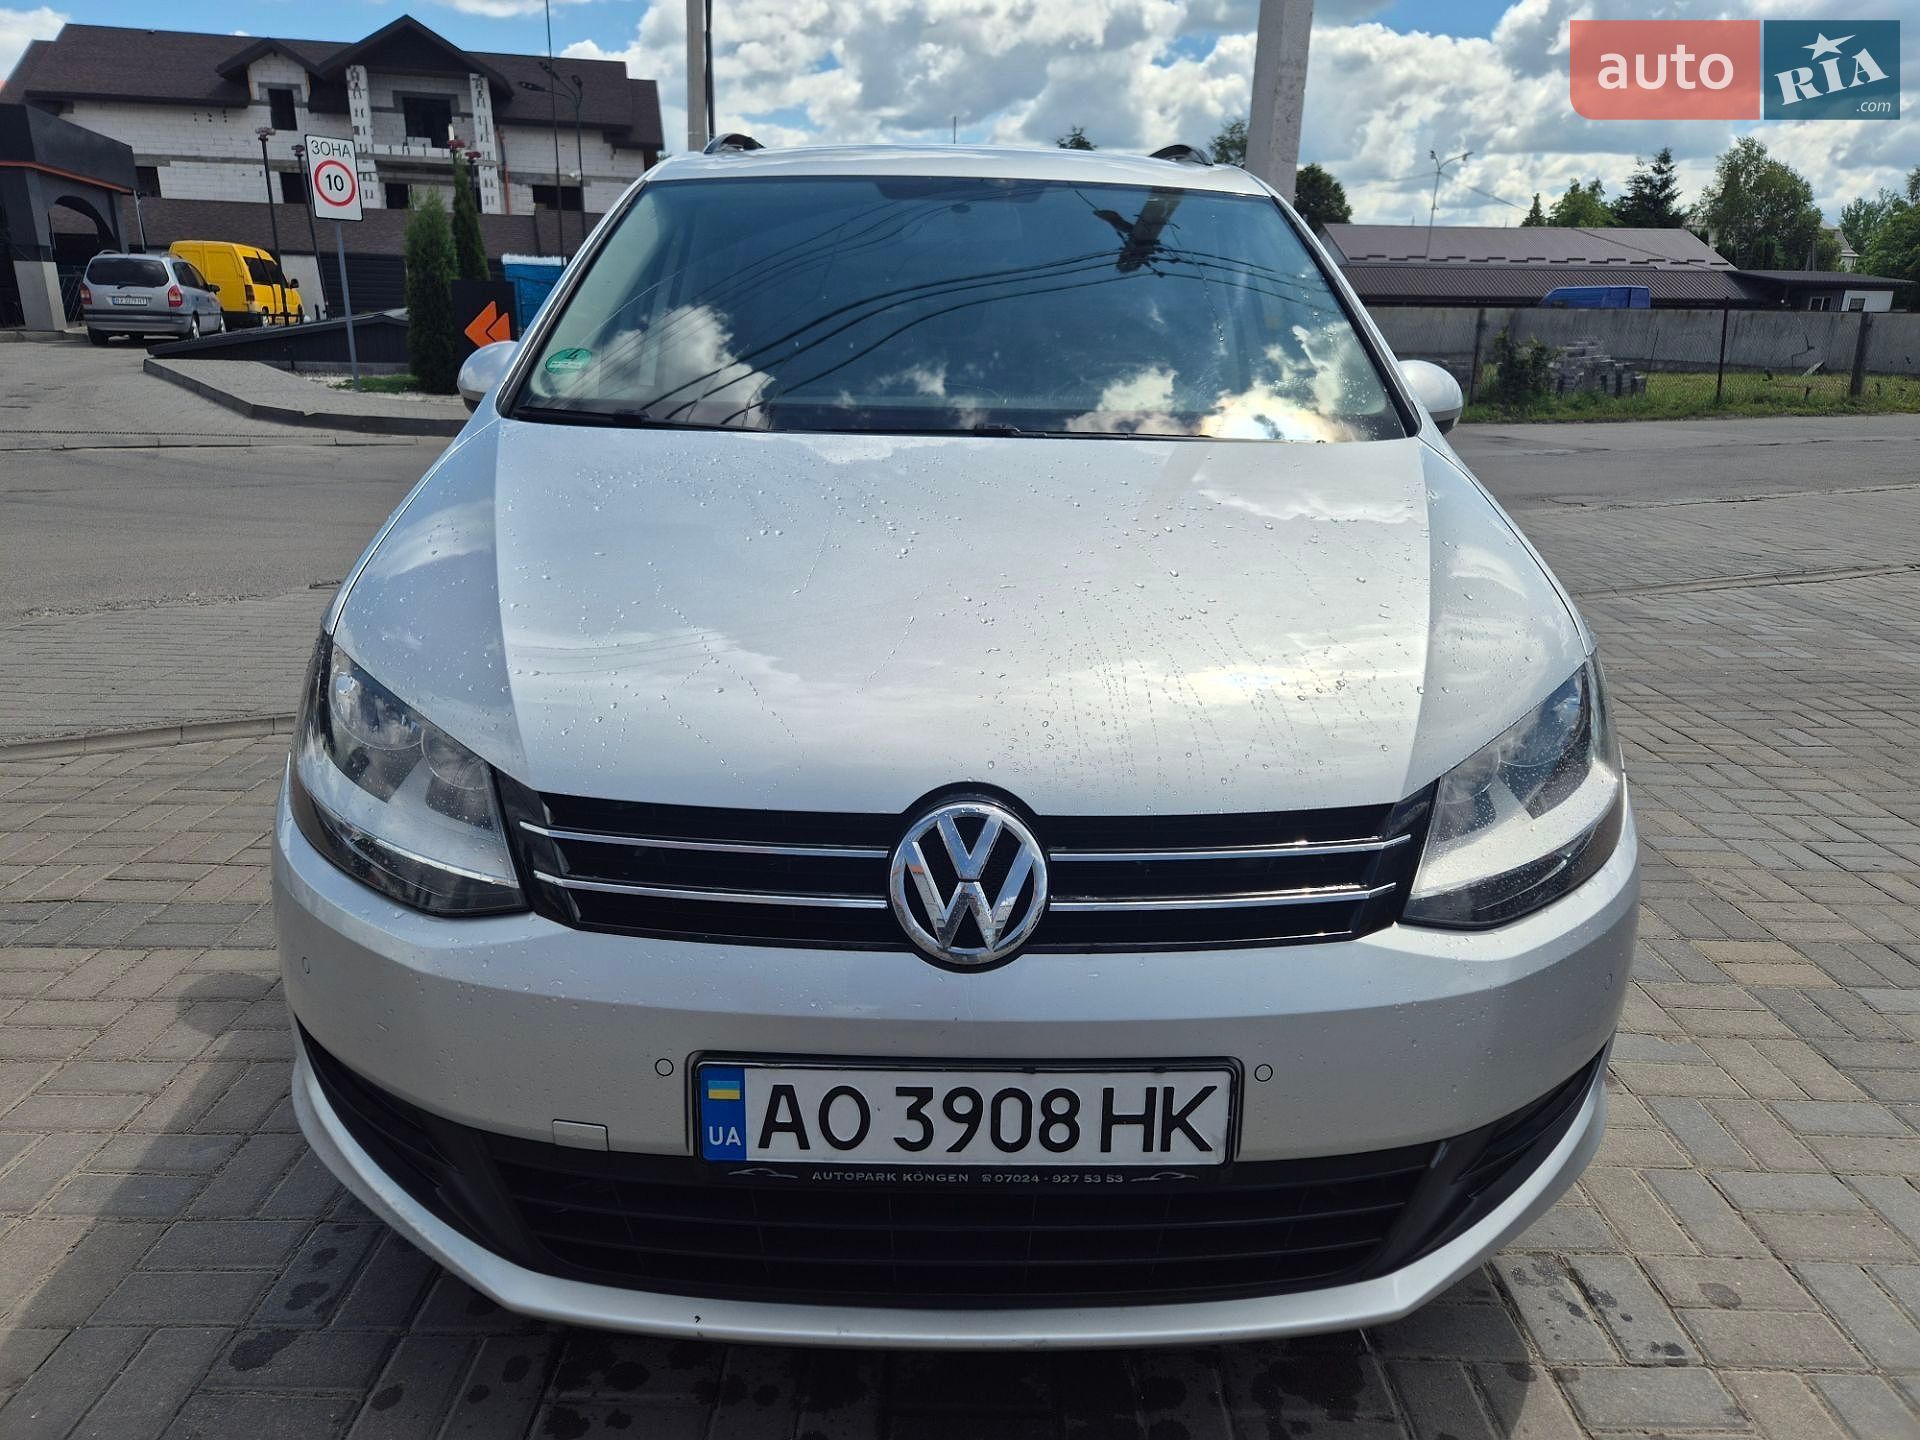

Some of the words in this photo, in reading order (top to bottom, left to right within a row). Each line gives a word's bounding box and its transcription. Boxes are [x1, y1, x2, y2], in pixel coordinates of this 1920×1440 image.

[311, 140, 352, 158] ЗОНА
[326, 173, 344, 191] 10
[758, 1084, 871, 1151] AO
[893, 1086, 1081, 1152] 3908
[1100, 1085, 1218, 1152] HK
[708, 1126, 742, 1146] UA
[812, 1171, 897, 1182] AUTOPARK
[903, 1170, 969, 1182] KÖNGEN
